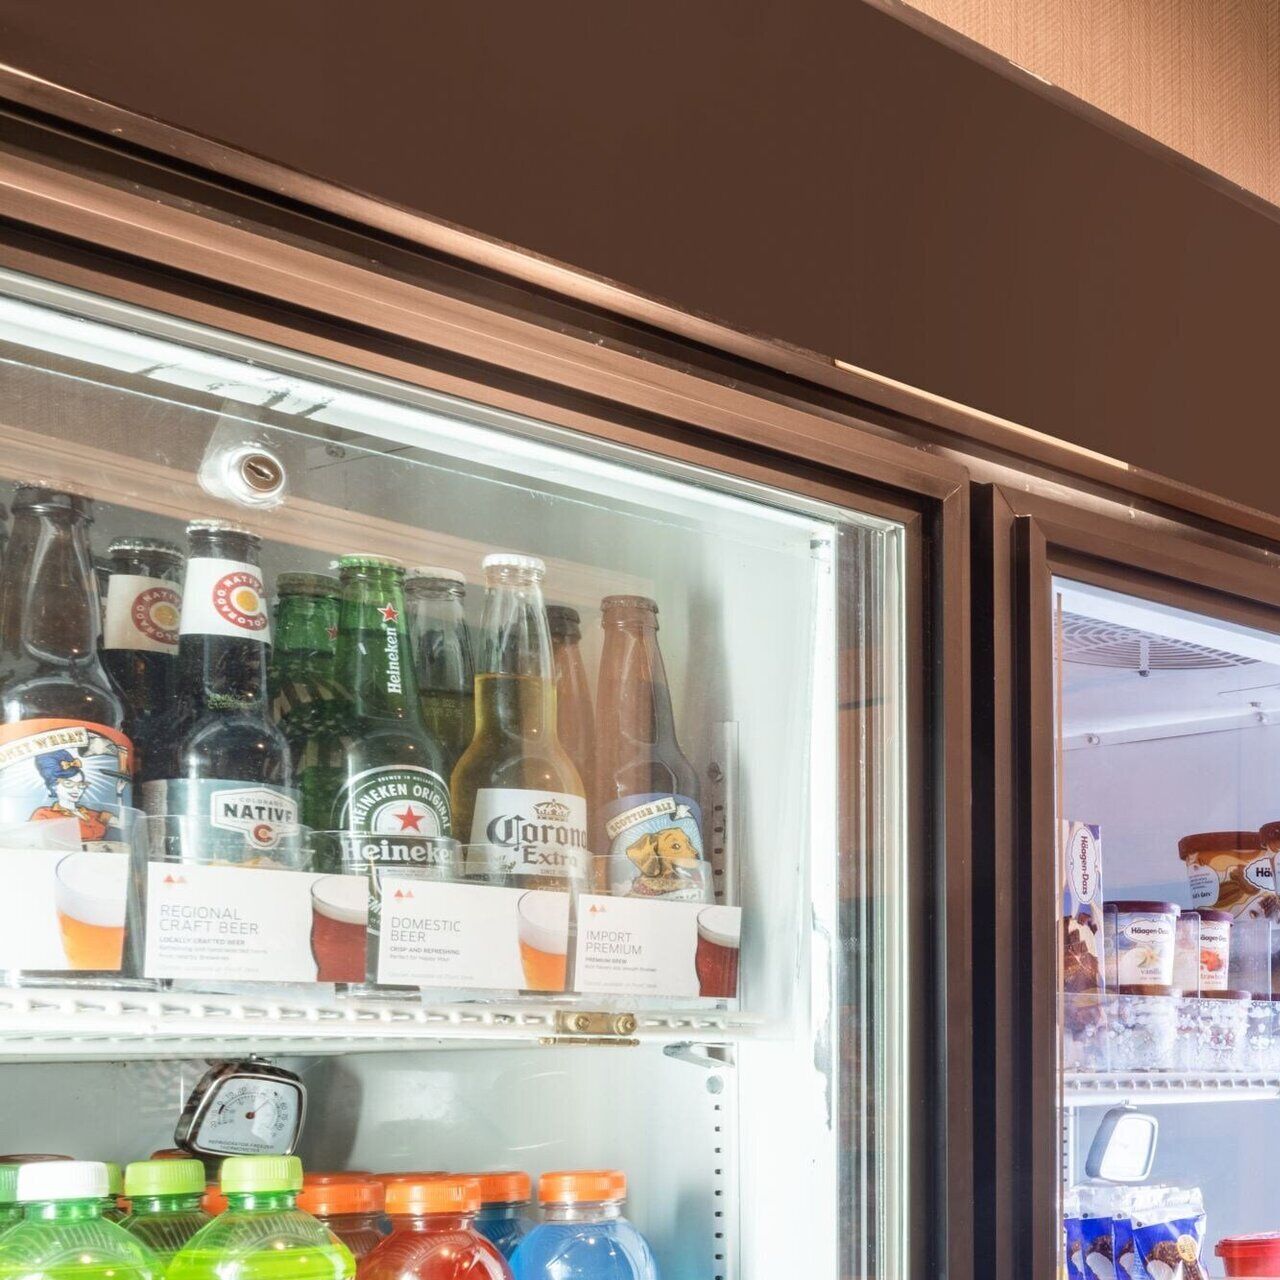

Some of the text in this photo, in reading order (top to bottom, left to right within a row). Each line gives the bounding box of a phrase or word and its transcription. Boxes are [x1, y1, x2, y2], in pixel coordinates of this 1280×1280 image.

[388, 626, 402, 694] Heineken
[160, 904, 242, 921] REGIONAL
[159, 919, 259, 935] CRAFT BEER
[391, 917, 461, 933] DOMESTIC
[391, 930, 426, 943] BEER
[586, 931, 632, 943] IMPORT
[585, 942, 643, 956] PREMIUM
